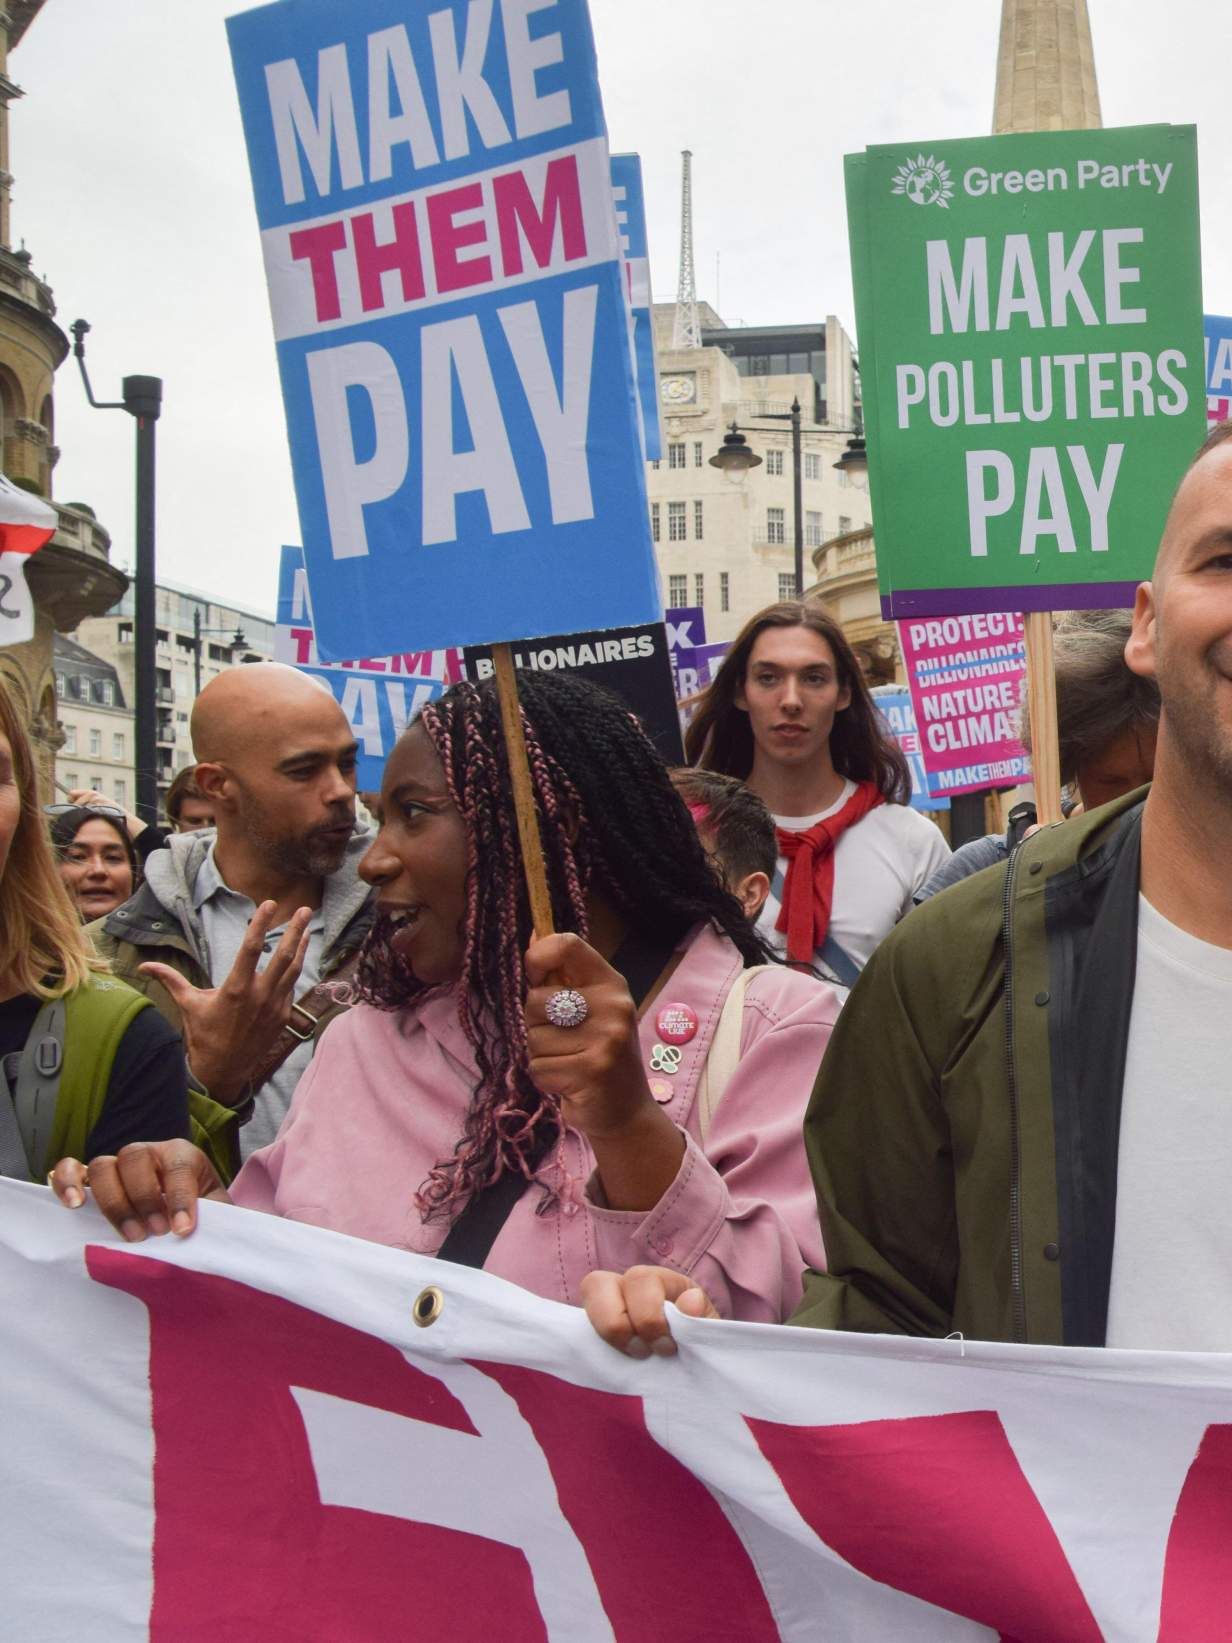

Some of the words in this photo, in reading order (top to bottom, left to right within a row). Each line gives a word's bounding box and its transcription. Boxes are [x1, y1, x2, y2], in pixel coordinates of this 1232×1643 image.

[263, 0, 573, 206] MAKE
[962, 166, 1069, 195] Green
[1077, 158, 1173, 194] Party
[288, 153, 588, 324] THEM
[926, 227, 1148, 335] MAKE
[305, 284, 600, 561] PAY
[895, 349, 1188, 429] POLLUTERS
[965, 443, 1124, 557] PAY
[909, 612, 1025, 651] PROTECT:
[312, 675, 433, 757] AY
[921, 681, 1015, 721] NATURE
[927, 708, 1024, 753] CLIMAT
